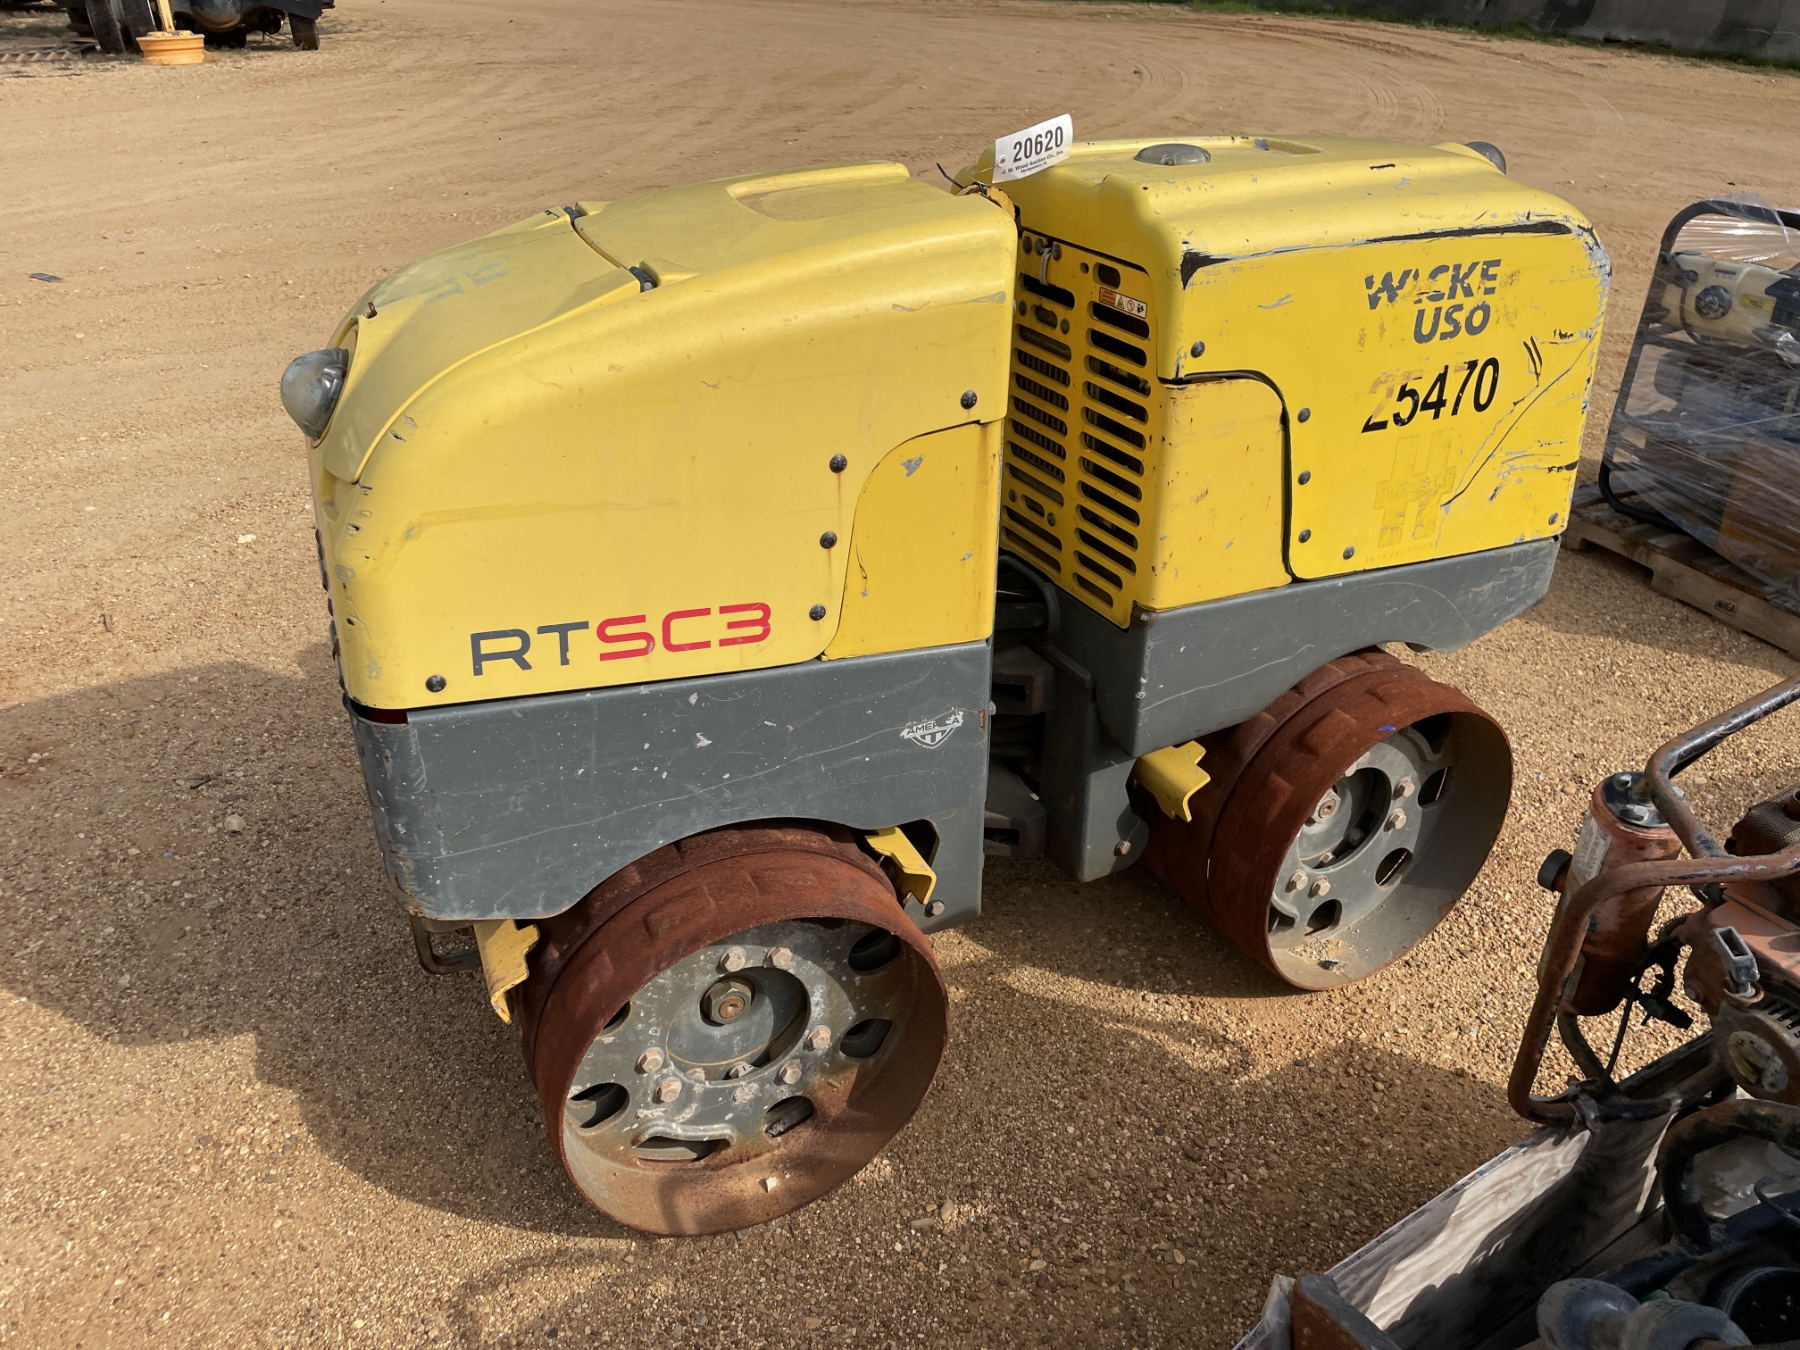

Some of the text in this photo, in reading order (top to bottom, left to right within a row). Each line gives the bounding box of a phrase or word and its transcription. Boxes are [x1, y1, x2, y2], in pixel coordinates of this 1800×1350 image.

[1013, 126, 1064, 163] 20620
[1015, 162, 1029, 171] Wood
[1029, 156, 1047, 166] Auction
[1413, 300, 1491, 344] USO
[1361, 357, 1500, 434] 25470
[470, 602, 772, 676] RTSC3
